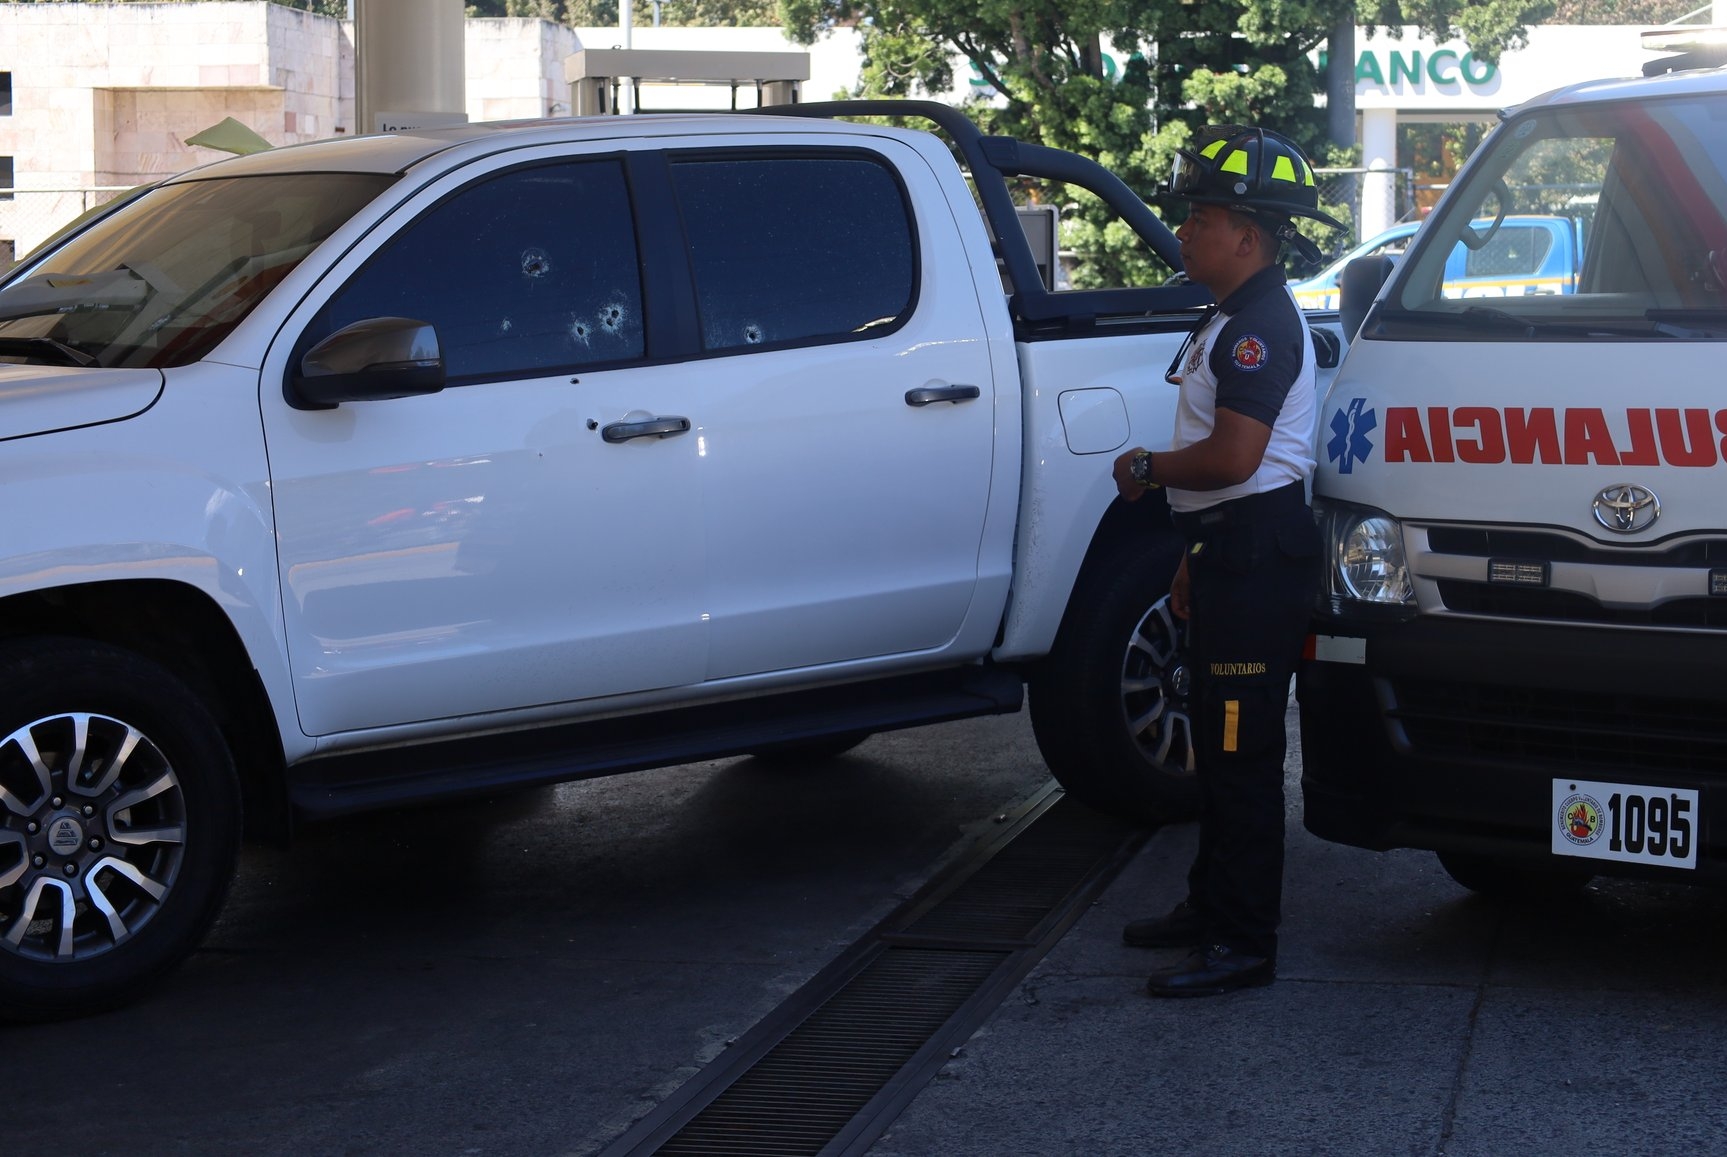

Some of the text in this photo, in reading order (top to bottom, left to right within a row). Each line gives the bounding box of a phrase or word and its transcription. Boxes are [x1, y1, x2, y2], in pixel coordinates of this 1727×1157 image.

[1319, 49, 1496, 85] ANCO
[1210, 662, 1266, 676] VOLUNTARIOS
[1566, 832, 1594, 844] GUATEMALA
[1608, 793, 1690, 858] 1095
